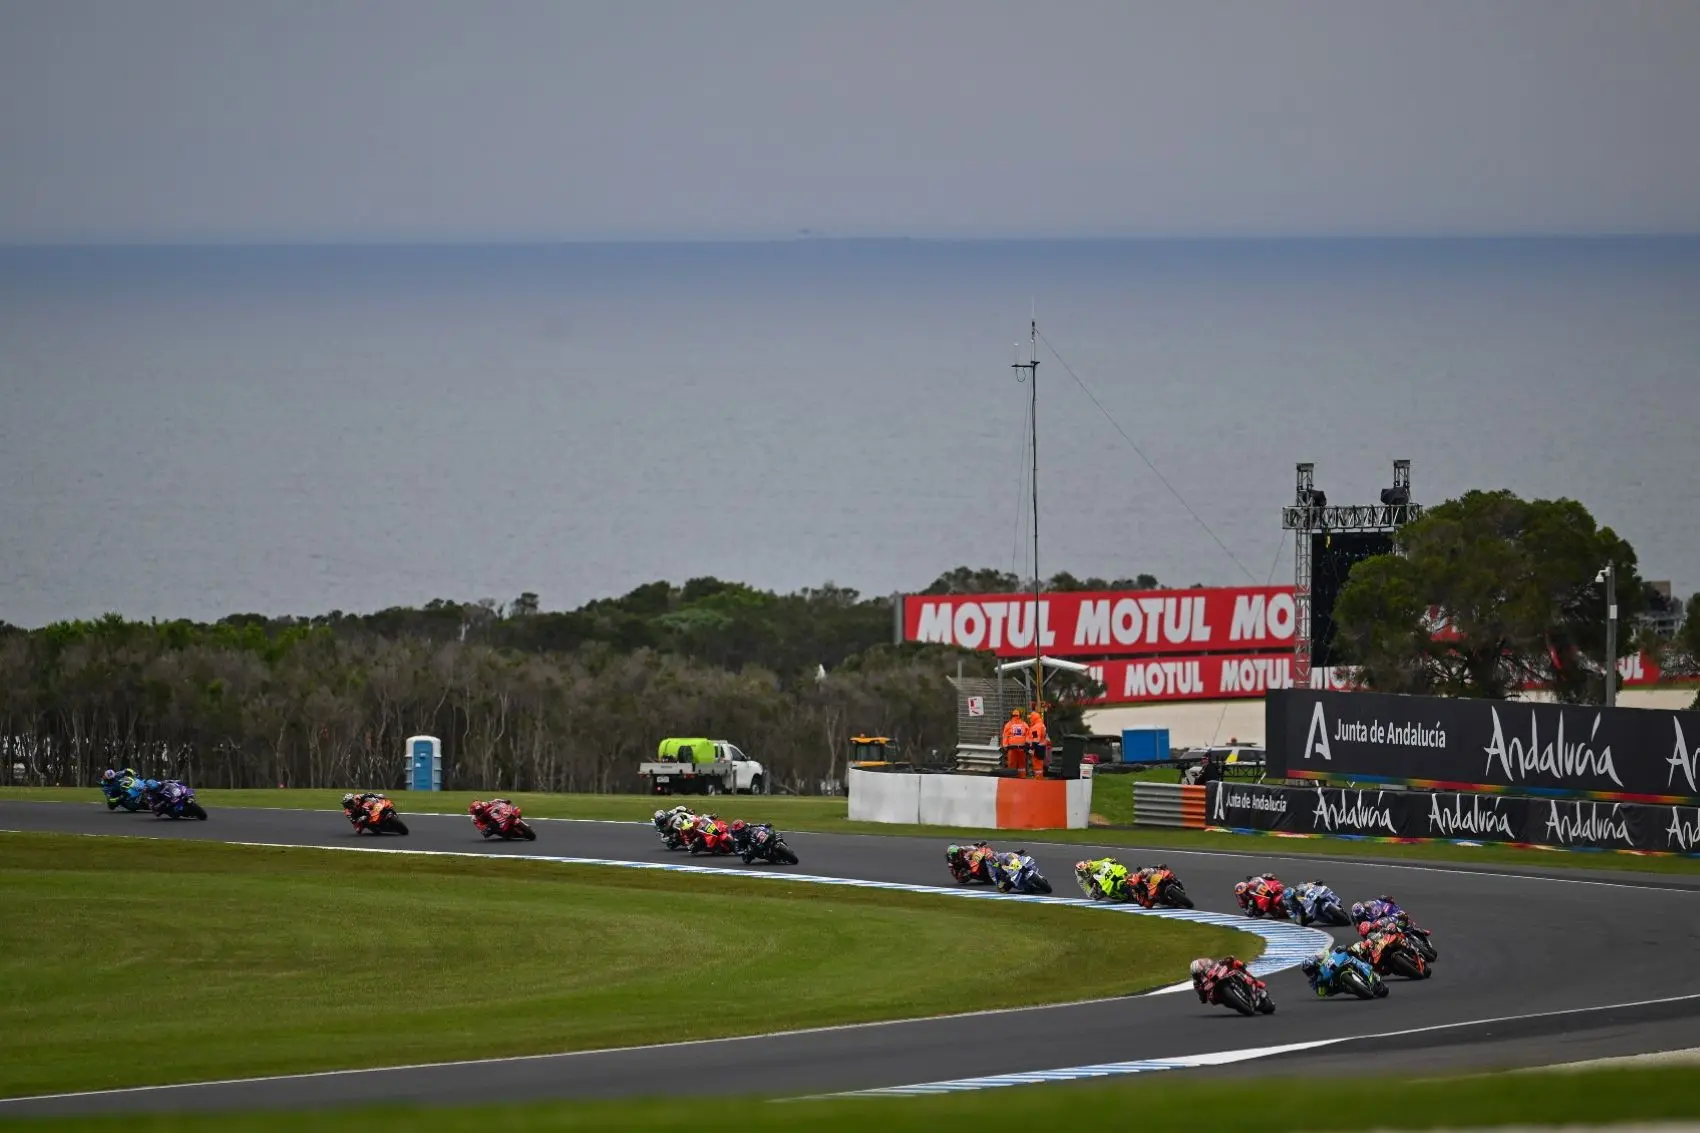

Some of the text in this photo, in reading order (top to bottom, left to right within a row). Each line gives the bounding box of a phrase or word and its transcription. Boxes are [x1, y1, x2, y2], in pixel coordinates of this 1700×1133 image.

[917, 601, 1056, 649] MOTUL
[1073, 597, 1212, 646] MOTUL
[1124, 660, 1203, 697] MOTUL
[1219, 658, 1294, 692] MOTUL
[1334, 718, 1446, 748] Junta de Andalucía
[1484, 705, 1624, 787] Andalucía
[1241, 792, 1251, 809] de
[1252, 794, 1287, 812] Andalucía
[1312, 787, 1397, 834] Andalucía
[1428, 792, 1515, 839] Andalucía
[1545, 799, 1635, 847] Andalucía
